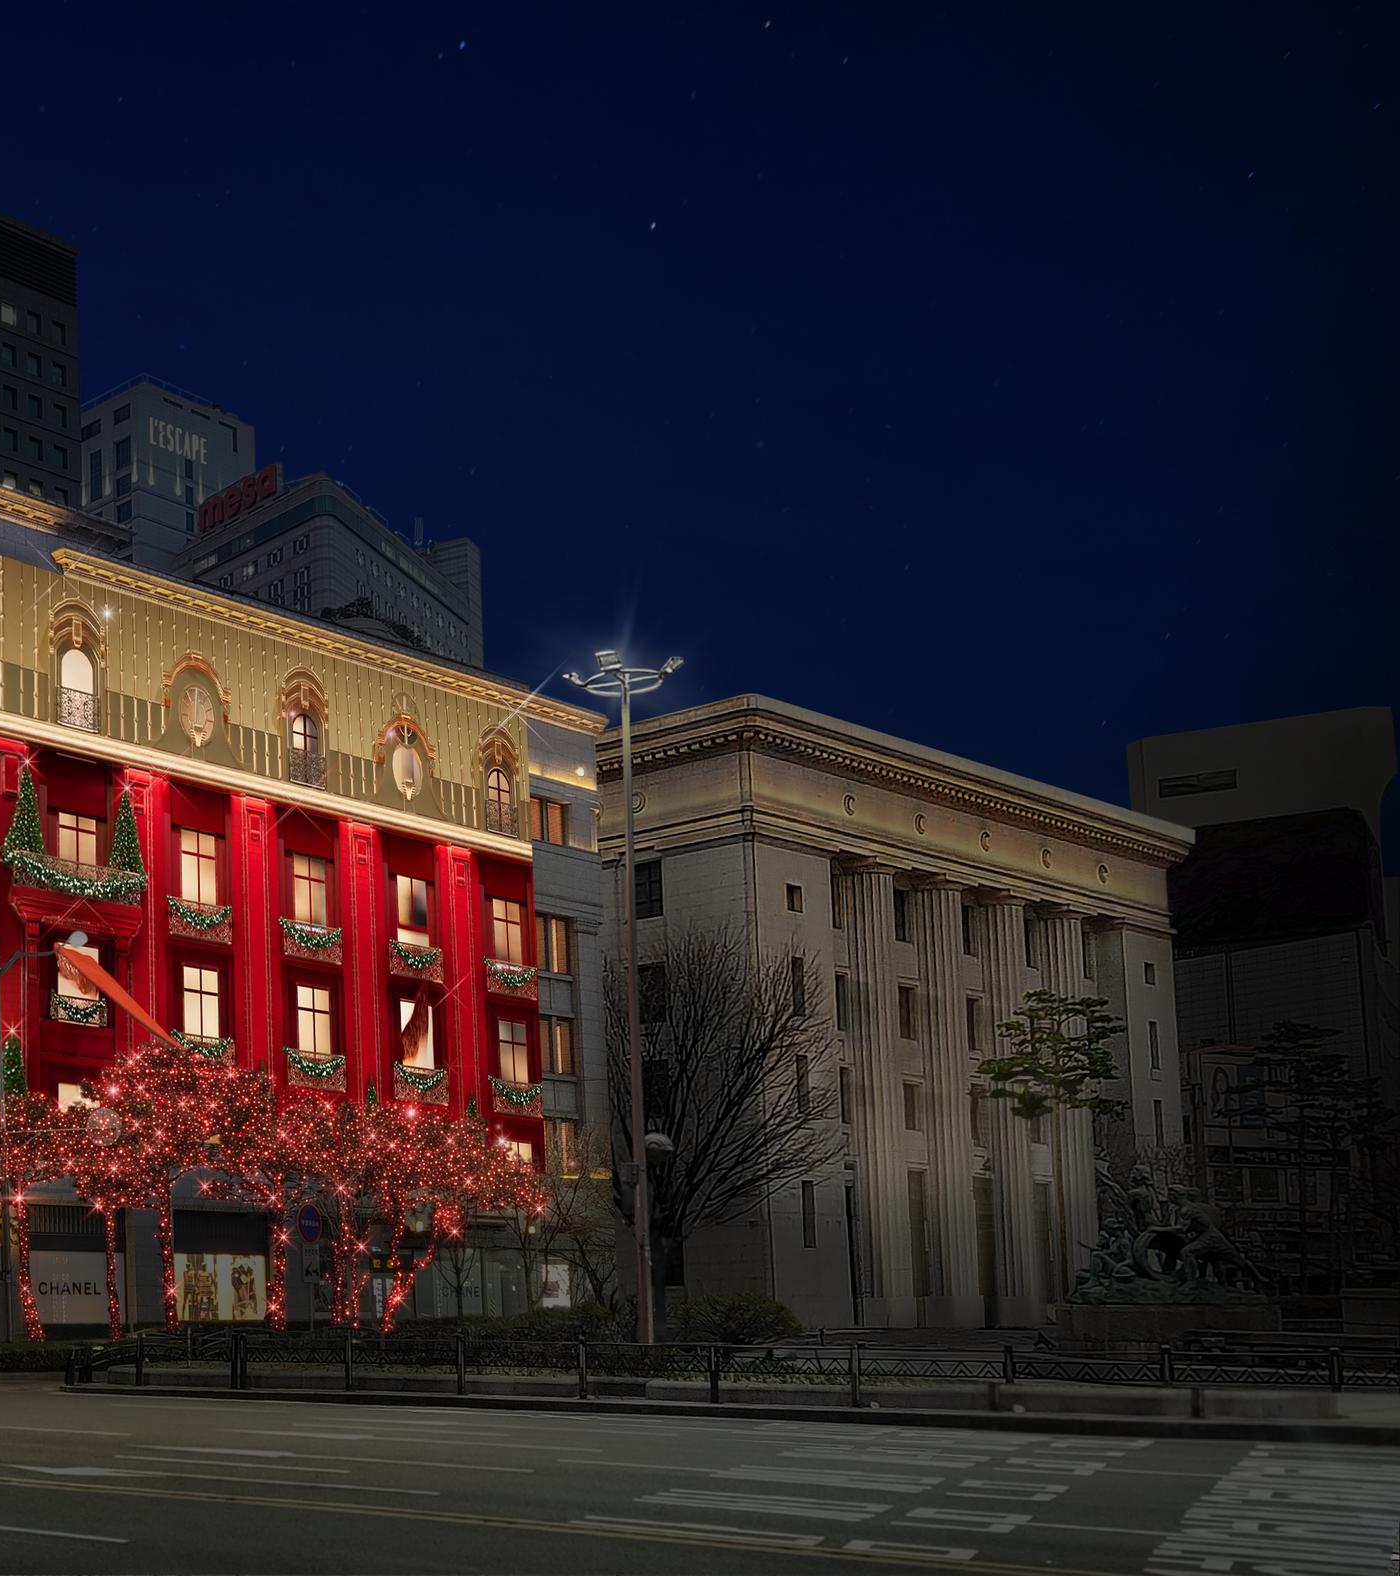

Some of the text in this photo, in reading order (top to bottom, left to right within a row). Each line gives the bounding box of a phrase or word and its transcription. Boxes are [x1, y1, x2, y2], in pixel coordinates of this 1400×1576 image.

[149, 416, 208, 465] L'ESCAPE
[199, 463, 277, 532] mesa
[38, 1281, 101, 1295] CHANEL
